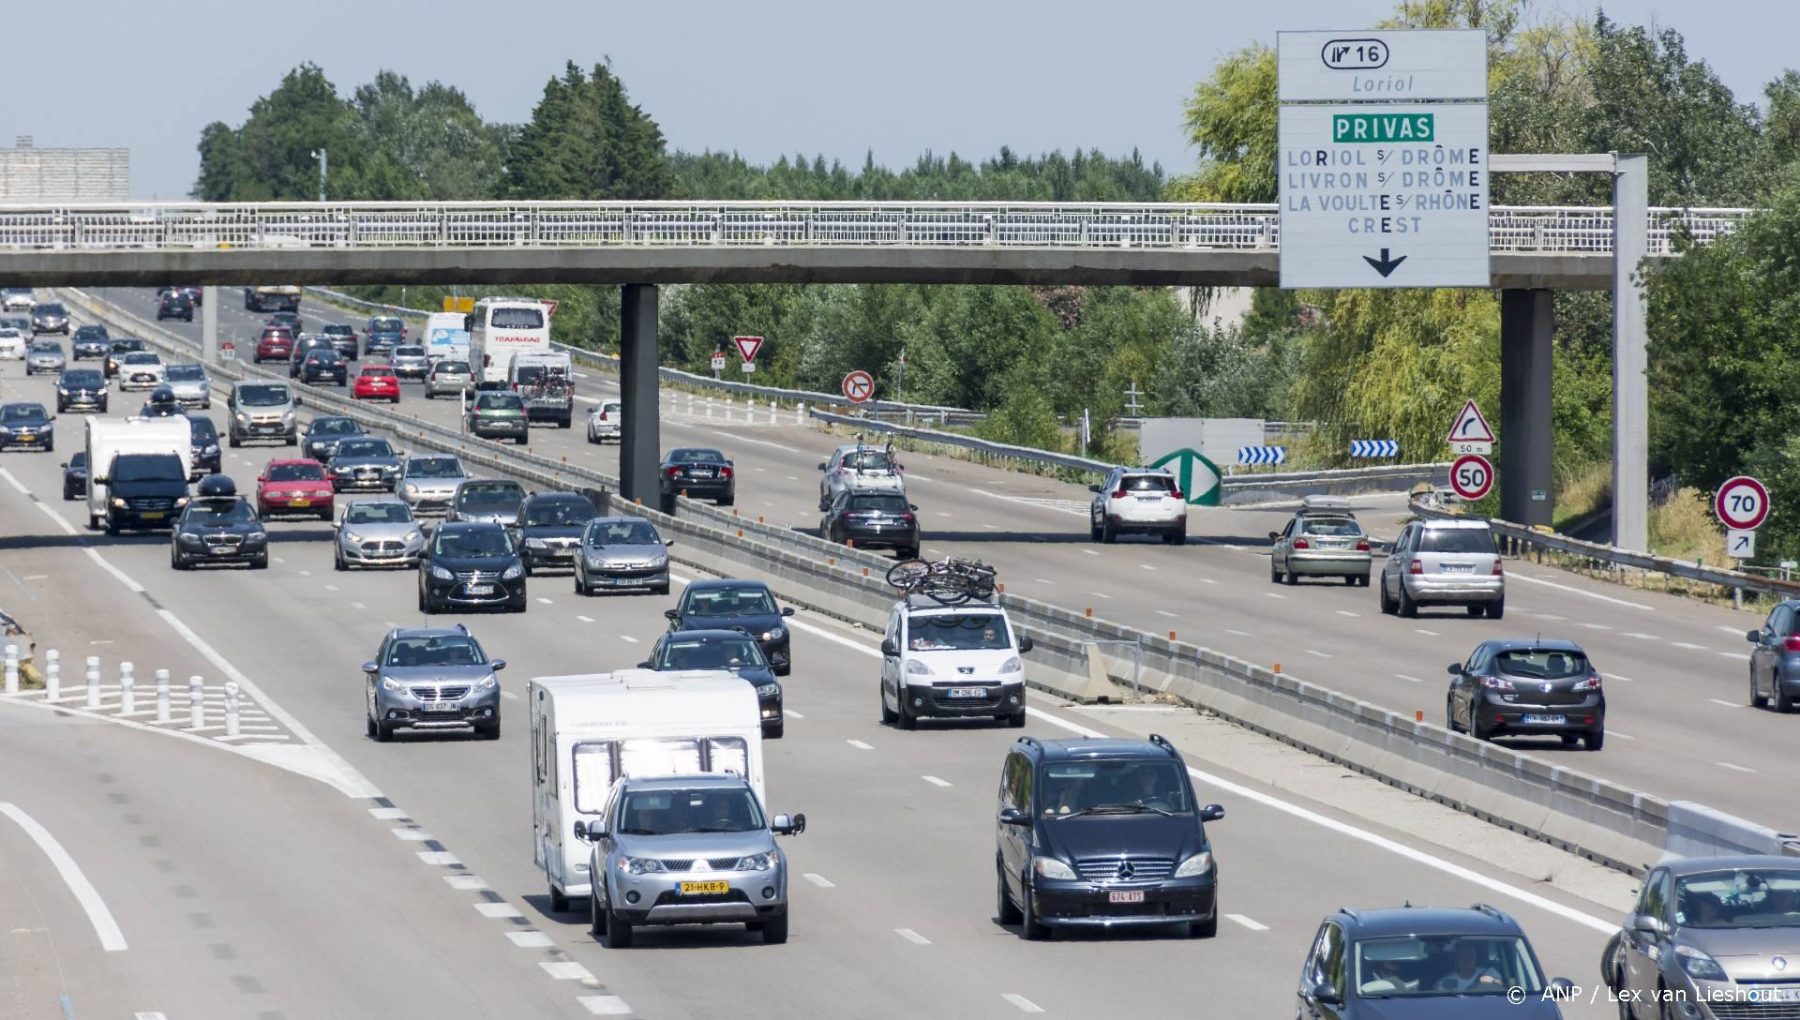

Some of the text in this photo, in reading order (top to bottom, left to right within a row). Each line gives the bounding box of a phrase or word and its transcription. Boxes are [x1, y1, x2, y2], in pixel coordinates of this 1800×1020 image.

[1356, 46, 1379, 62] 16
[1352, 75, 1414, 92] Loriol
[1336, 117, 1431, 140] PRIVAS
[1288, 150, 1366, 167] LORIOL
[1402, 145, 1480, 165] DRÔME
[1289, 172, 1368, 189] LIVRON
[1403, 167, 1480, 187] DRÔME
[1289, 196, 1312, 212] LA
[1319, 194, 1391, 211] VOULTE
[1348, 217, 1422, 234] CREST
[1460, 444, 1472, 453] 50
[1459, 469, 1485, 487] 50
[1730, 495, 1755, 513] 70
[684, 882, 725, 892] 21-HKB-9
